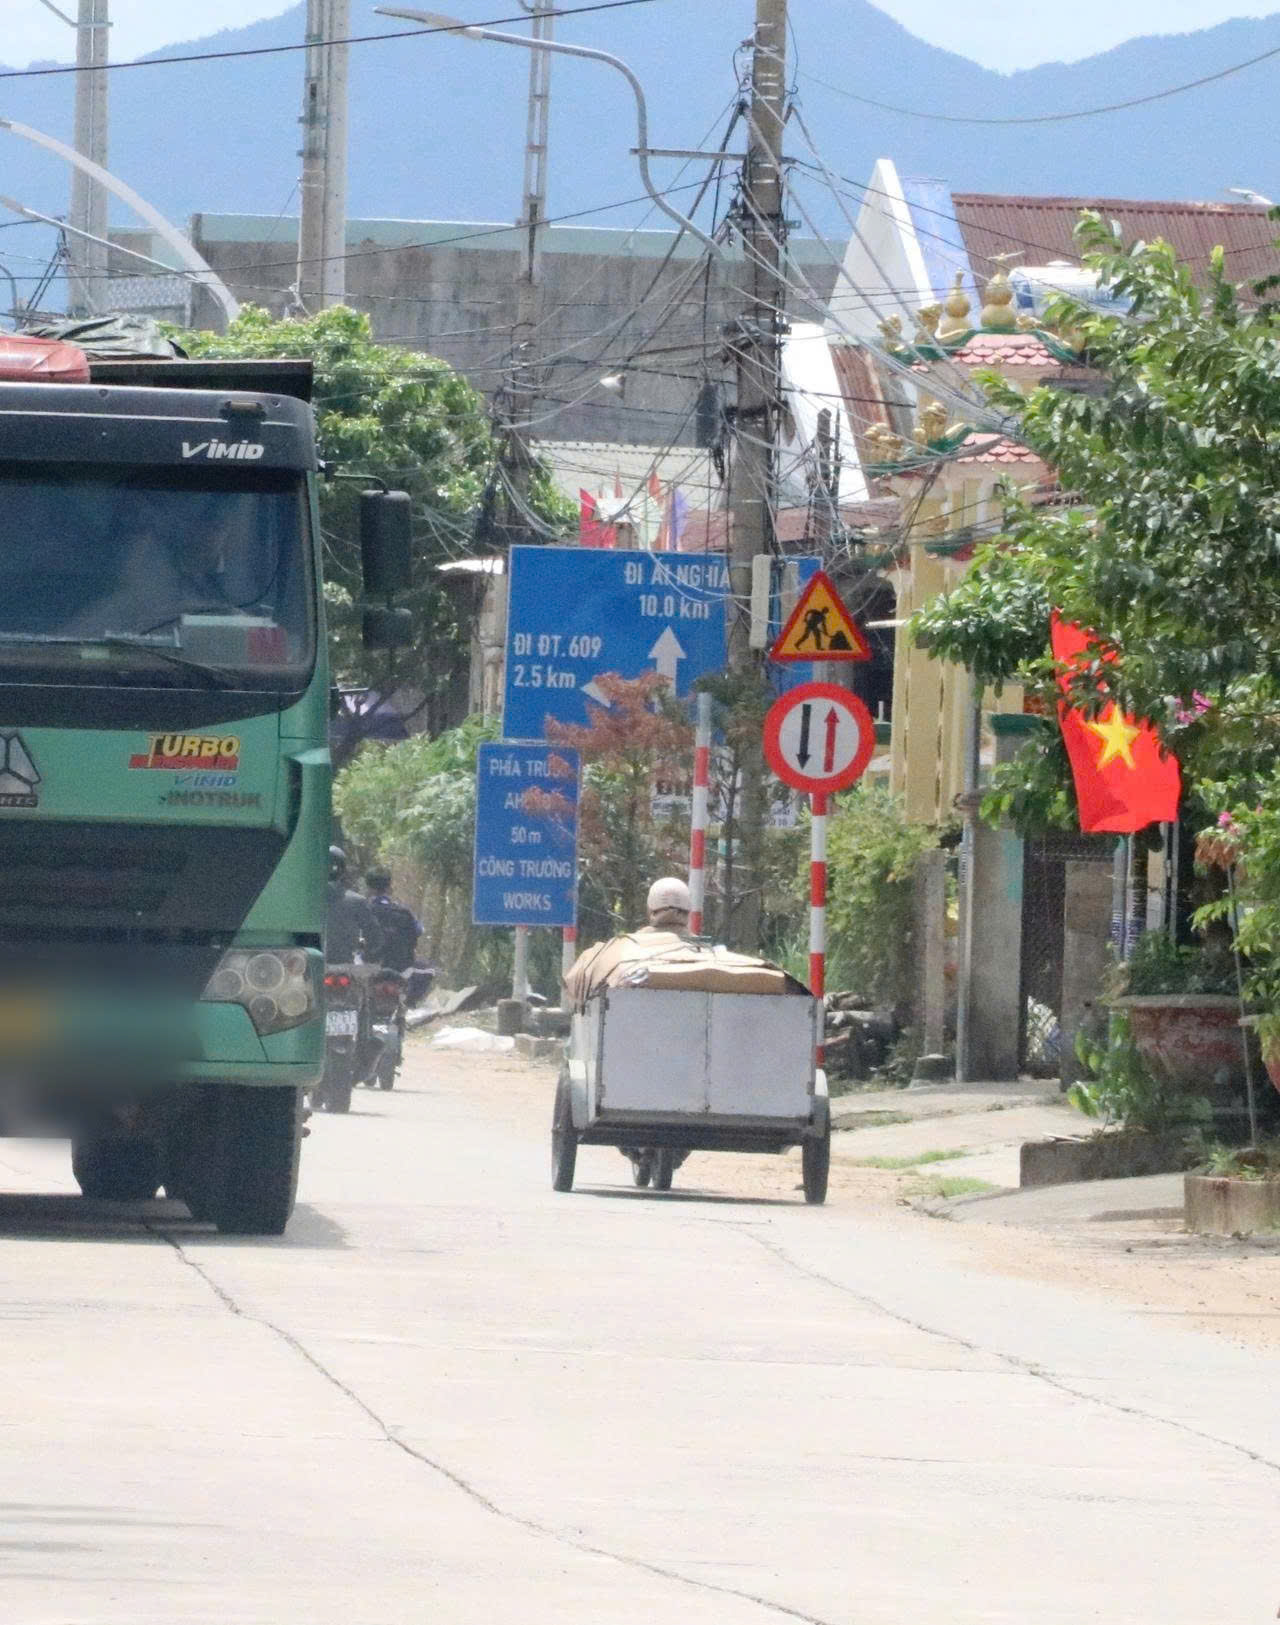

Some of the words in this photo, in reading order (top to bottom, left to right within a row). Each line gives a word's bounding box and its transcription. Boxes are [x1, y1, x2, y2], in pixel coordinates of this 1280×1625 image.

[624, 562, 643, 585] ĐI
[640, 595, 675, 617] 10.0
[680, 596, 710, 619] km
[513, 633, 531, 656] ĐI
[537, 635, 602, 658] ĐT.609
[513, 665, 543, 688] 2.5
[547, 665, 576, 689] km
[147, 735, 240, 767] TURBO
[528, 831, 542, 844] m
[478, 855, 515, 877] CÔNG
[503, 892, 552, 911] WORKS
